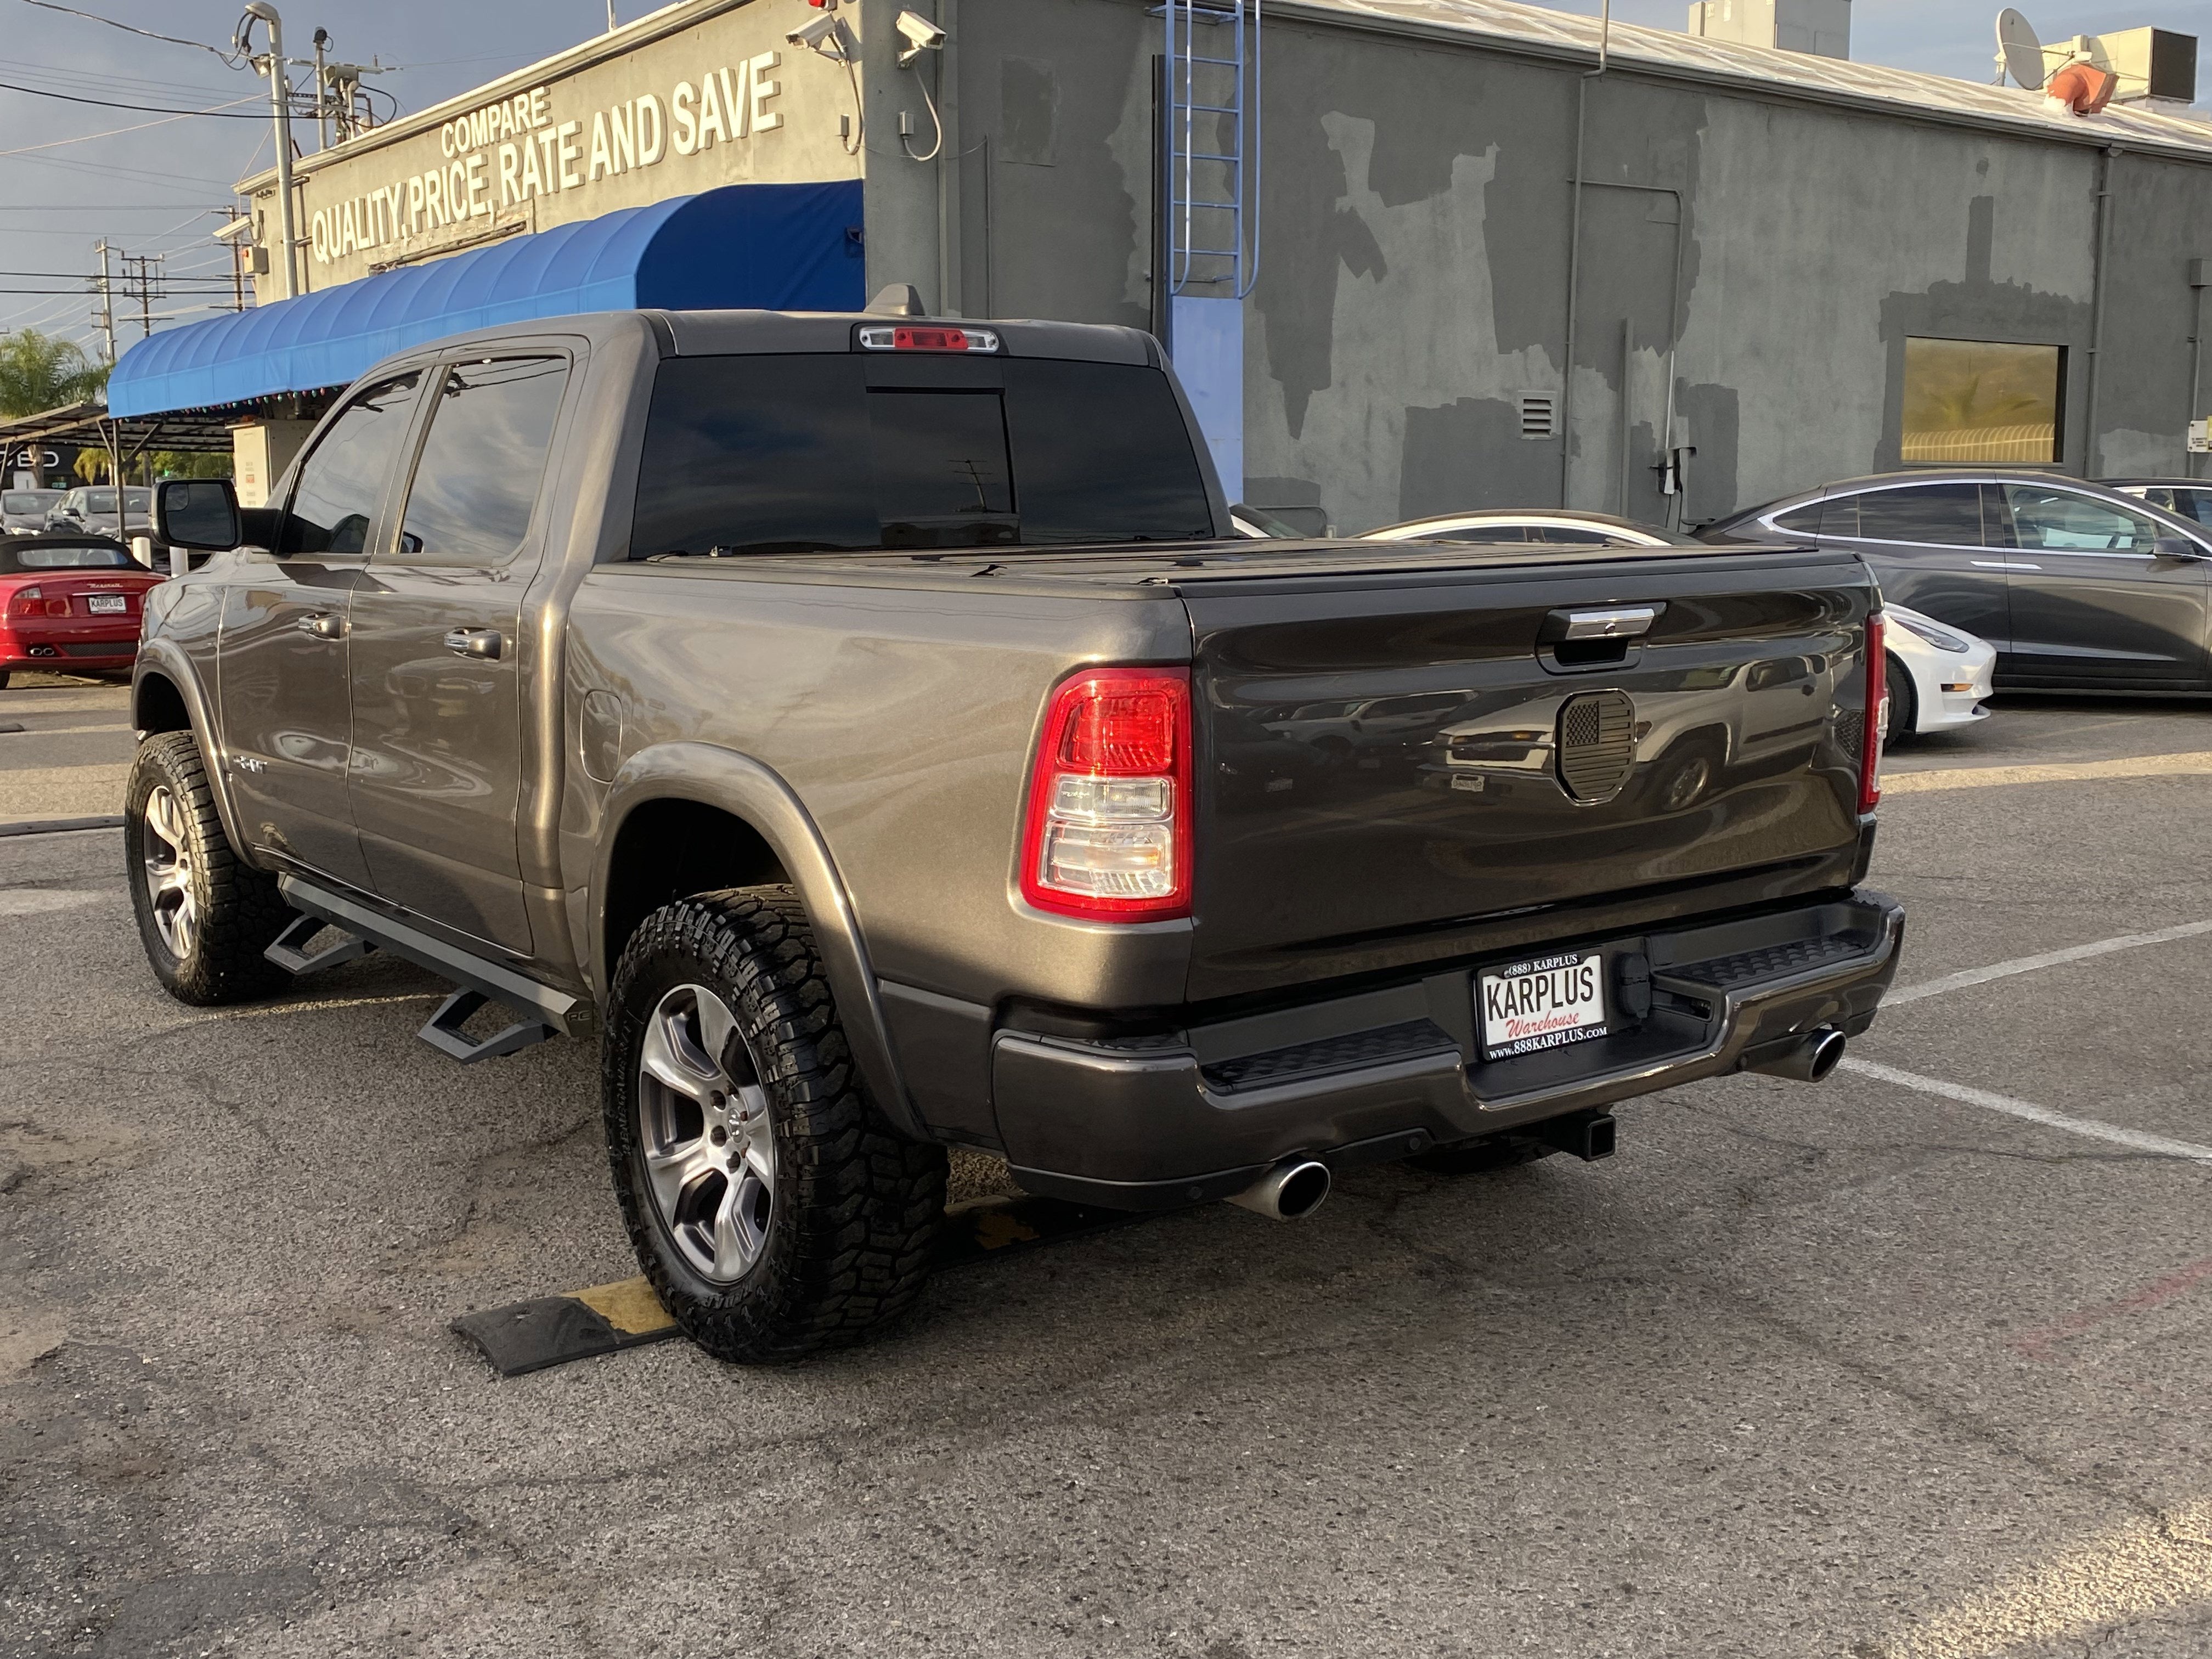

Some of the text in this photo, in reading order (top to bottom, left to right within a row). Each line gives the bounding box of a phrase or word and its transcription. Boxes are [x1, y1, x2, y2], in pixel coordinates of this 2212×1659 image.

[441, 86, 552, 159] COMPARE
[499, 120, 585, 206] RATE
[589, 94, 668, 182] AND
[673, 50, 784, 156] SAVE
[91, 599, 123, 607] KARPLUS
[1509, 954, 1578, 976] (888) KARPLUS
[1487, 966, 1593, 1021] KARPLUS
[1505, 1010, 1579, 1039] Warehouse
